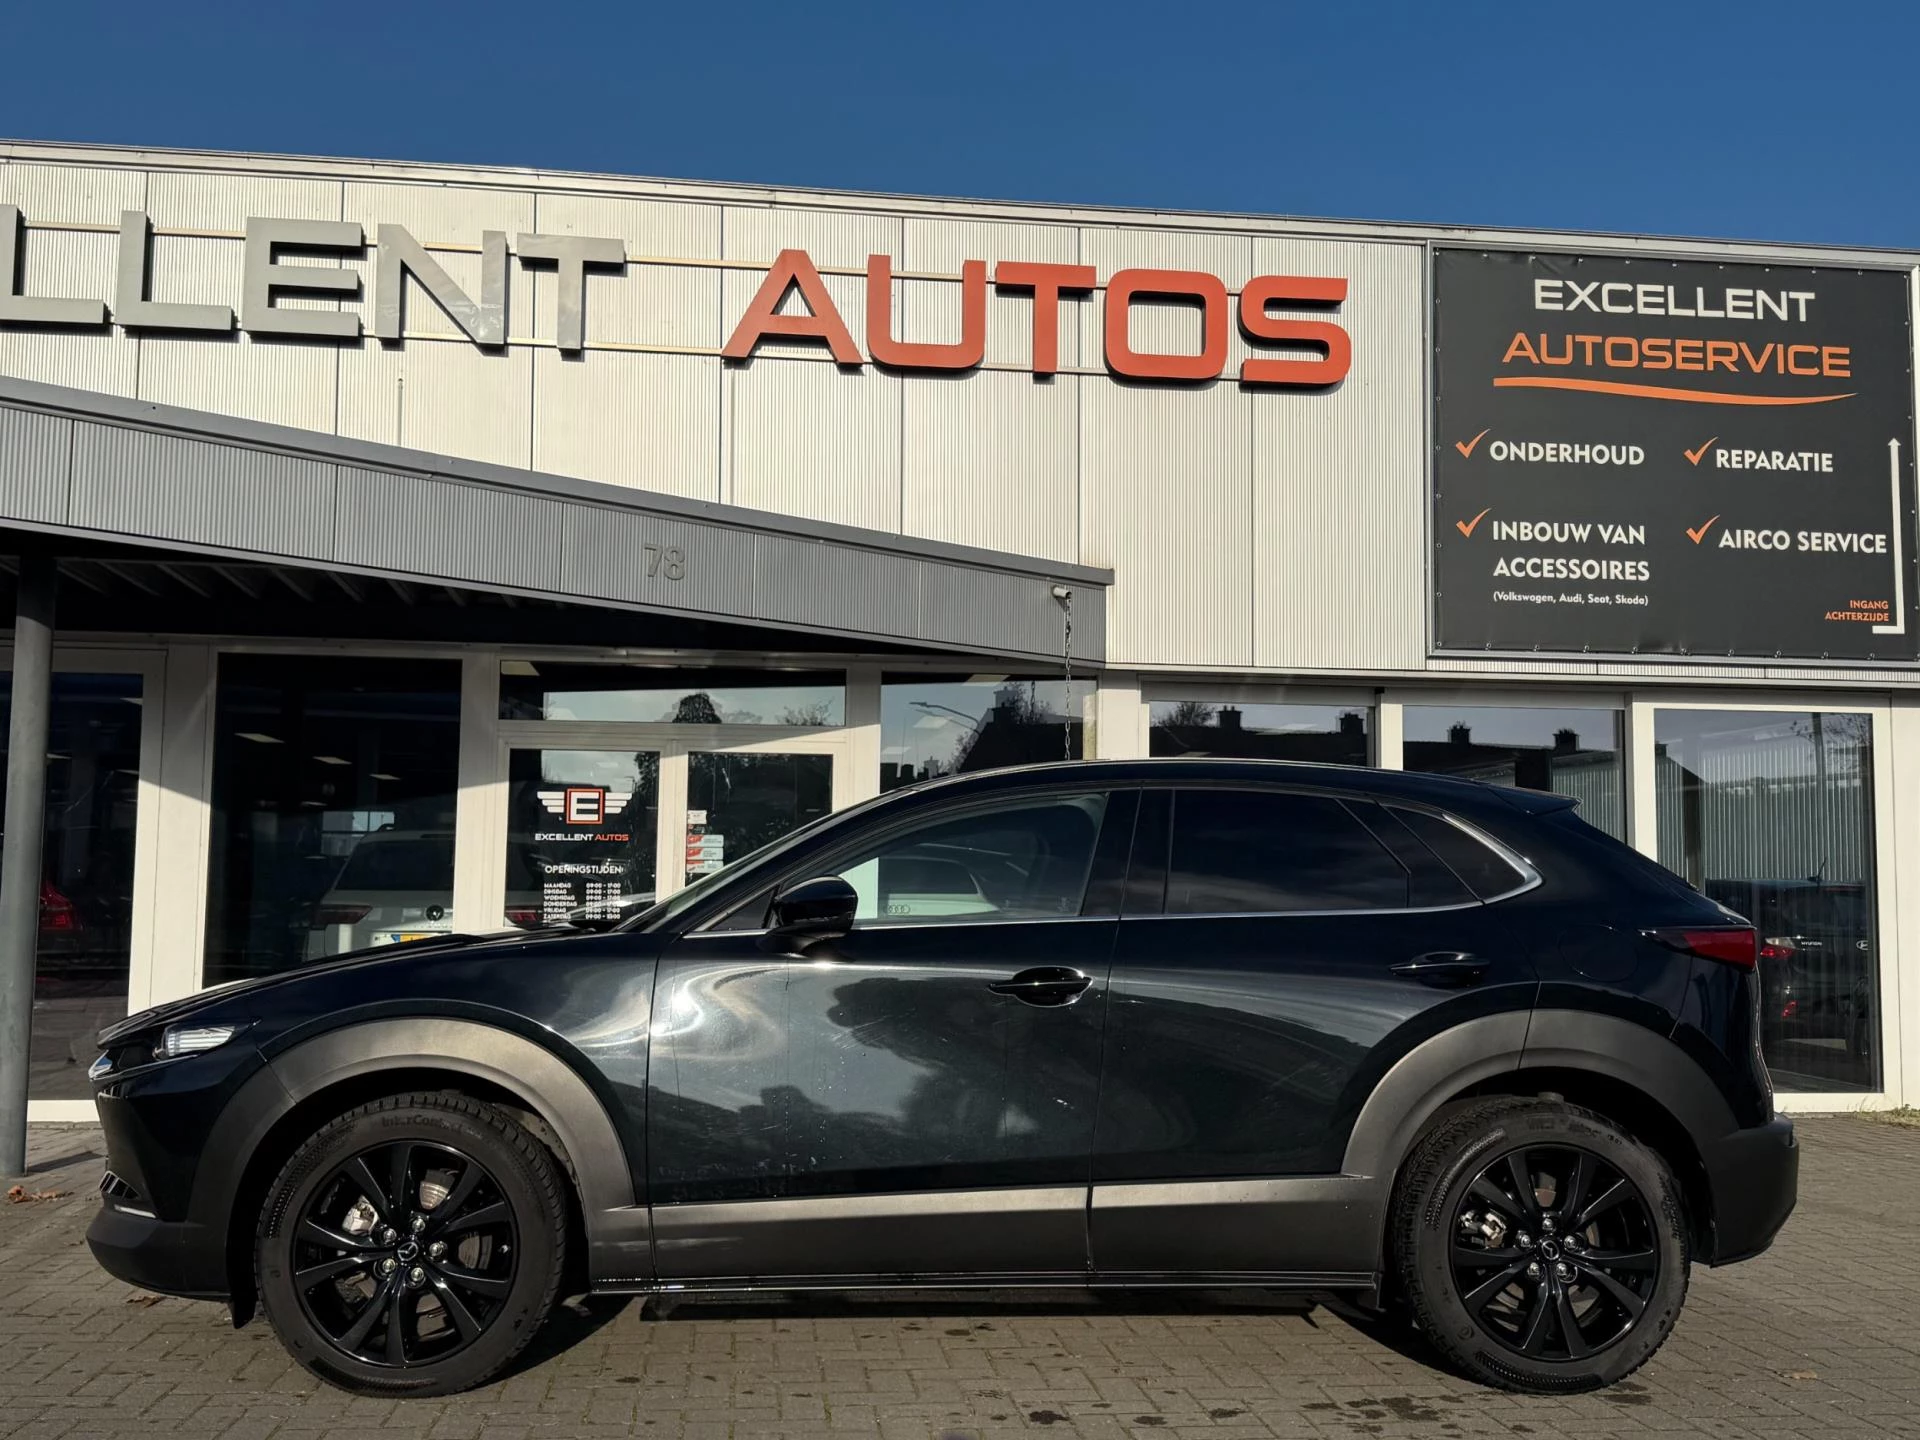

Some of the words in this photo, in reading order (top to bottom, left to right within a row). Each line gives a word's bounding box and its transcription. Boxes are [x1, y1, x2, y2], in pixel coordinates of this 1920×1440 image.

[1534, 278, 1816, 322] EXCELLENT
[723, 250, 1350, 386] AUTOS
[1503, 332, 1851, 377] AUTOSERVICE
[1489, 440, 1645, 466] ONDERHOUD
[1715, 448, 1834, 473] REPARATIE
[1492, 520, 1592, 544] INBOUW
[1597, 523, 1646, 545] VAN
[1718, 528, 1791, 551] AIRCO
[1797, 530, 1887, 554] SERVICE
[643, 543, 686, 581] 78
[1492, 556, 1650, 581] ACCESSOIRES
[1493, 591, 1556, 605] (Volkswagen,
[1559, 593, 1585, 605] Audi,
[1587, 593, 1612, 606] Seat,
[1615, 594, 1649, 607] Skoda)
[1849, 600, 1889, 609] INGANG
[1825, 611, 1889, 622] ACHTERZIJDE
[535, 833, 594, 841] EXCELLENT
